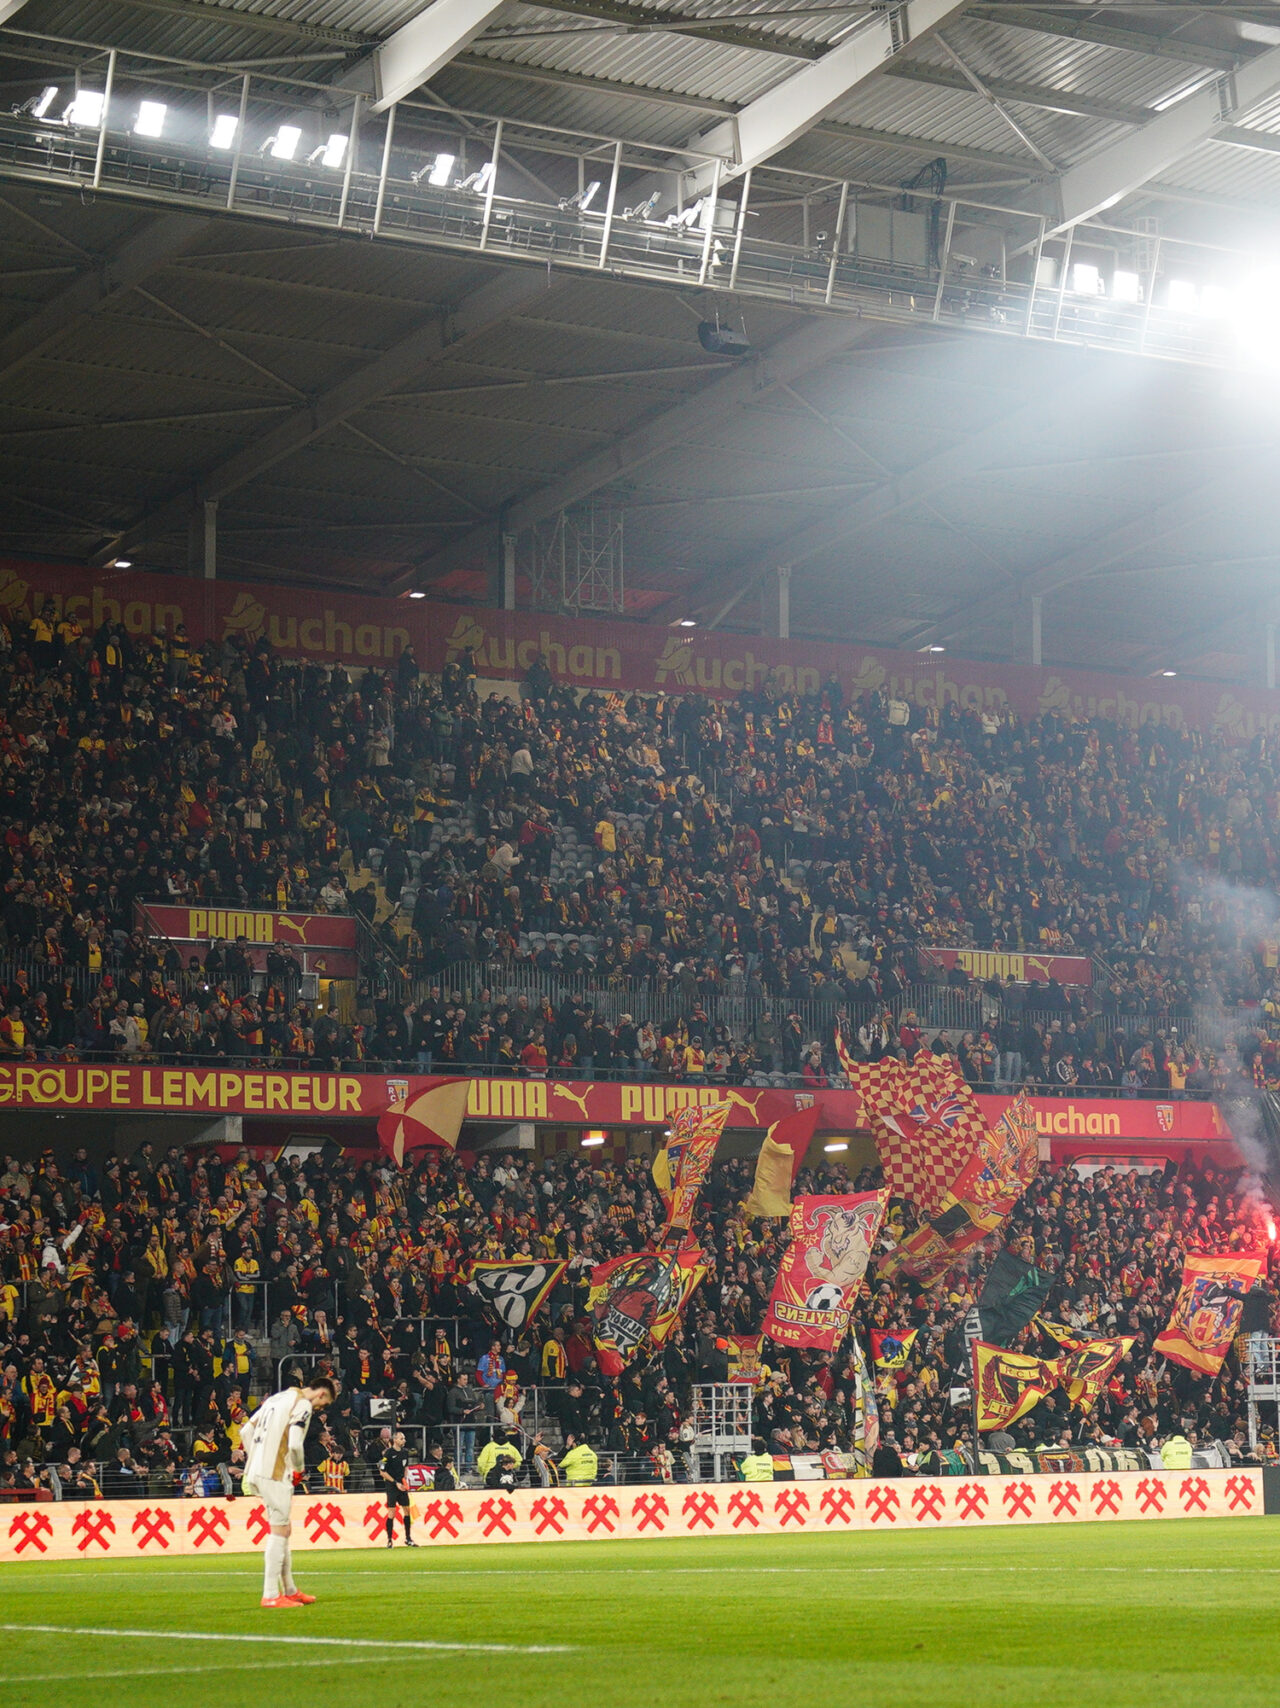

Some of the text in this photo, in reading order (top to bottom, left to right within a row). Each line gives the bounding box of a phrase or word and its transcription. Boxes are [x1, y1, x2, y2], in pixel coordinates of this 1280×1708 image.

[189, 910, 274, 942] PUMA
[958, 951, 1025, 980] PUMA
[0, 1067, 362, 1112] GROUPE LEMPEREUR
[466, 1079, 548, 1118] UMA
[1034, 1105, 1121, 1135] uchan
[406, 1469, 436, 1487] EN
